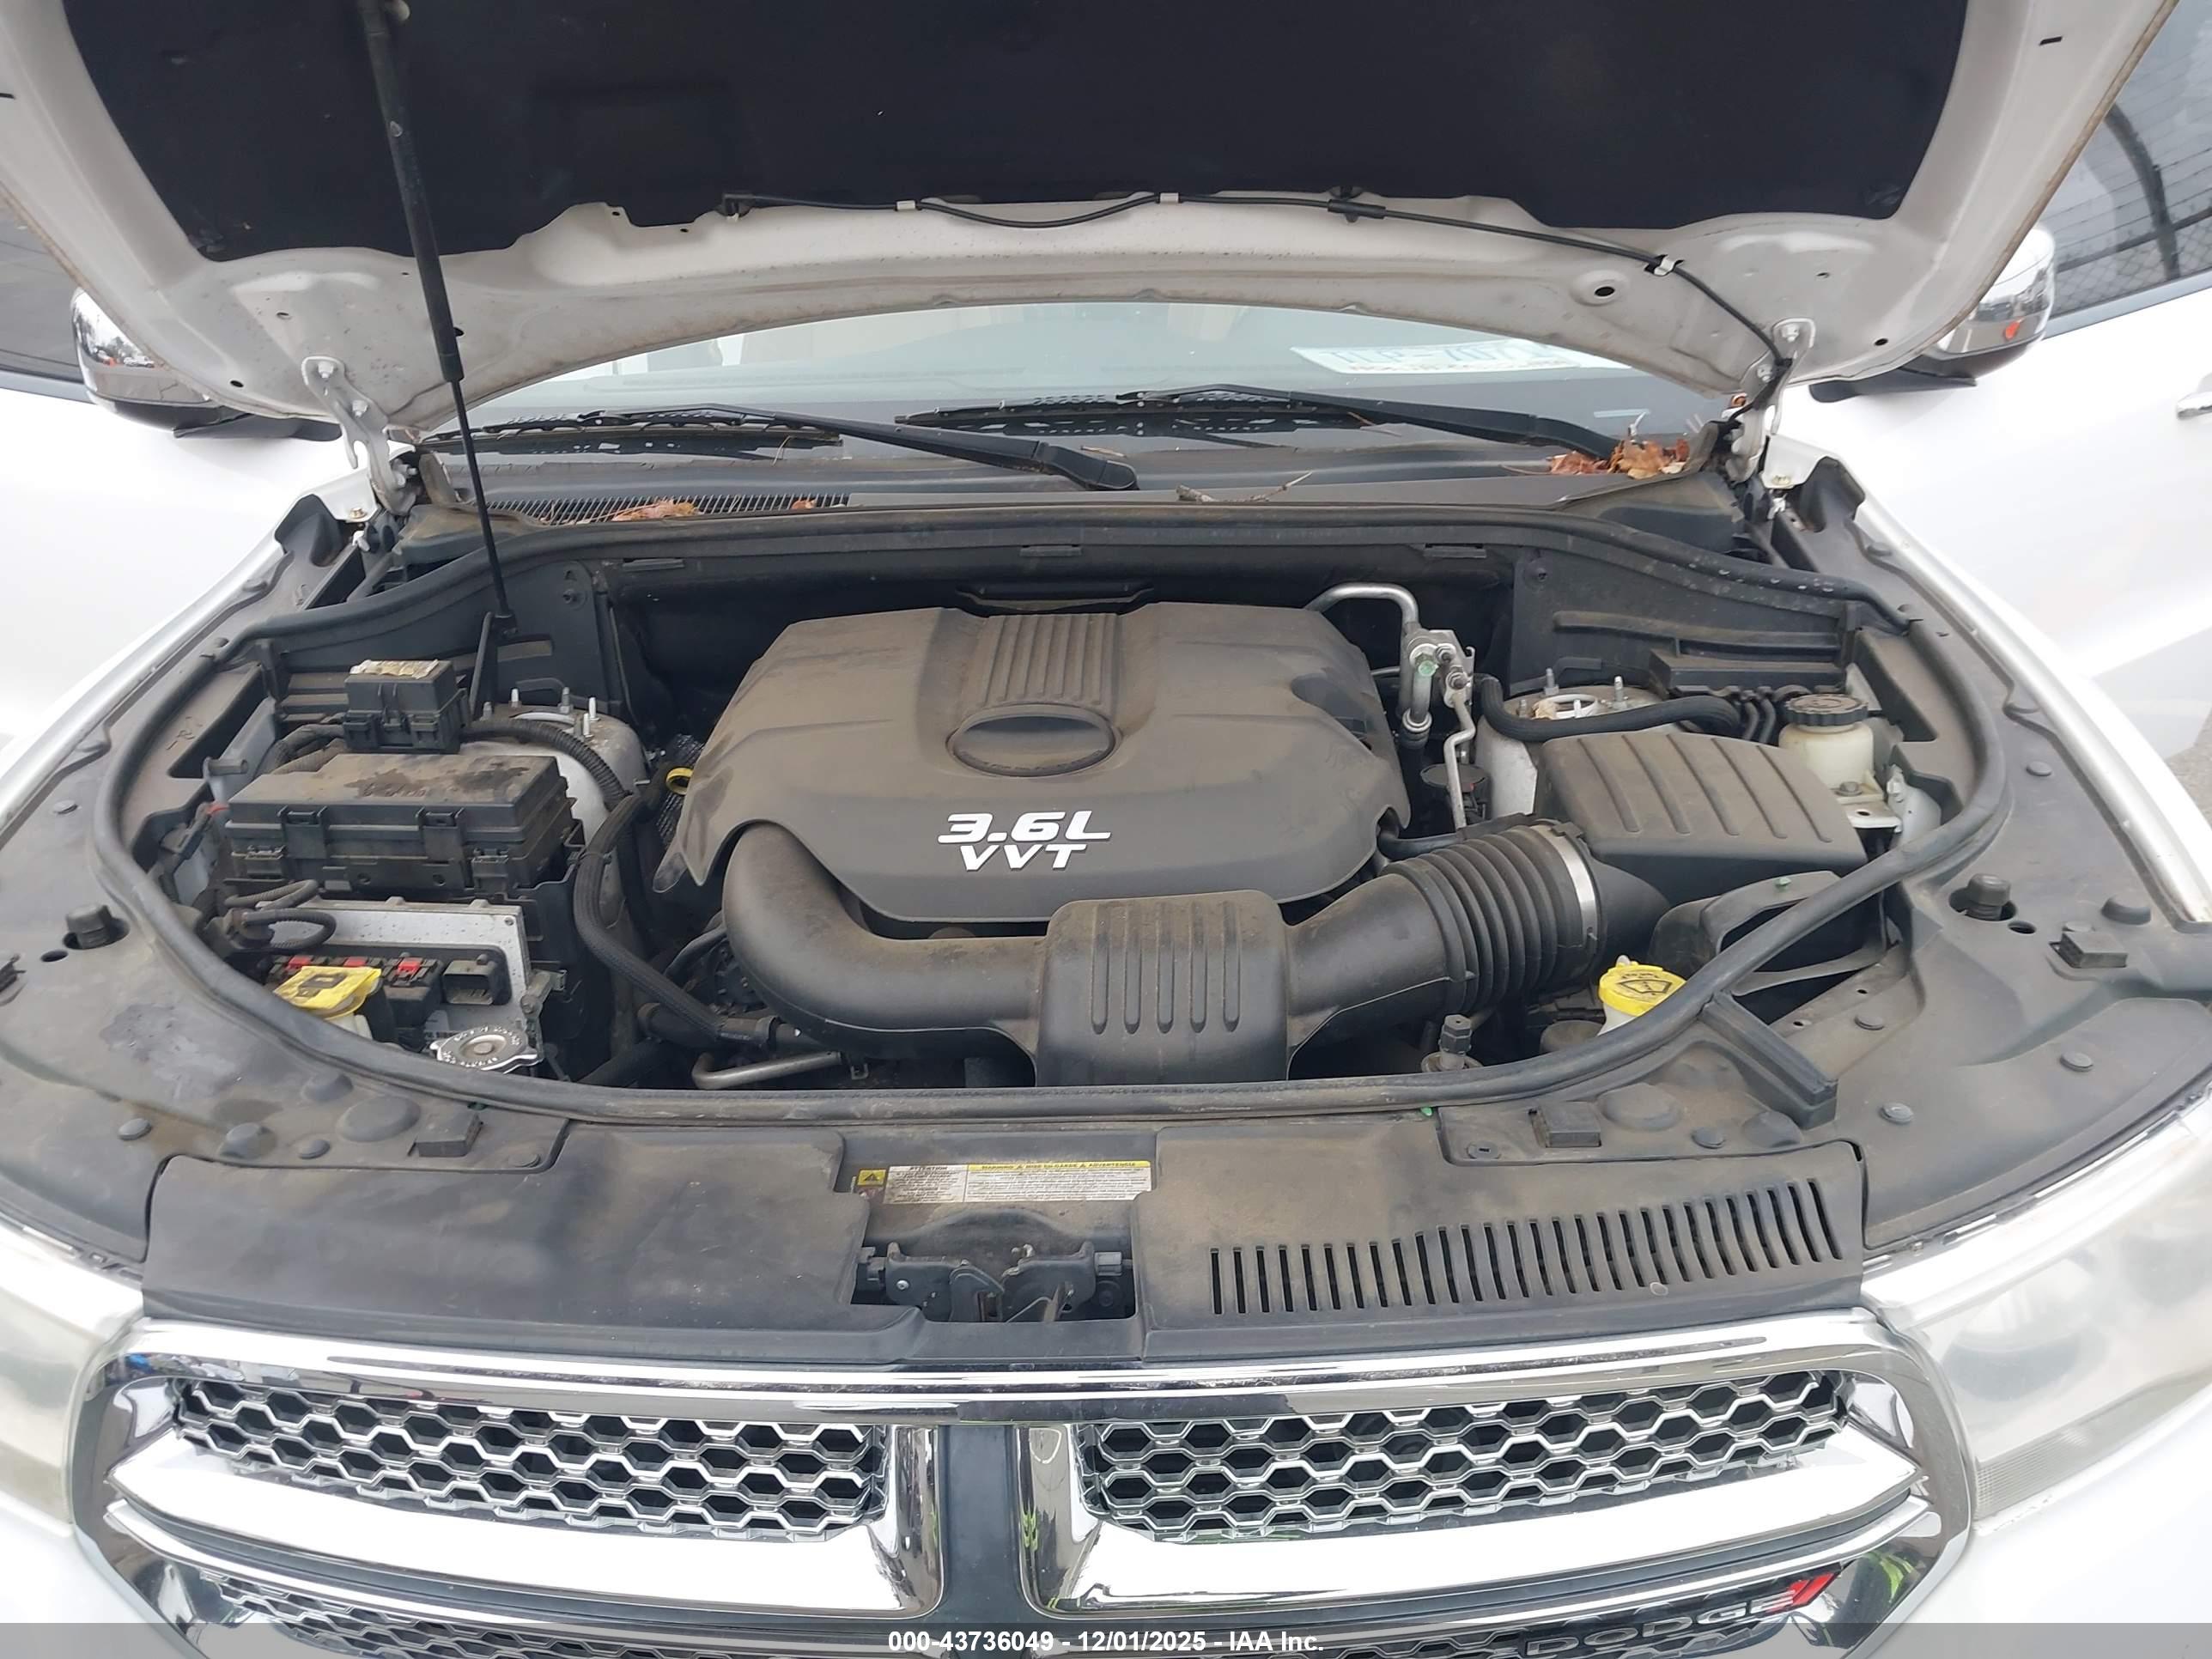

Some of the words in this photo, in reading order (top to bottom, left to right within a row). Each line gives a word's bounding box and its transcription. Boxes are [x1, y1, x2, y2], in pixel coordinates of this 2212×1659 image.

[938, 811, 1112, 843] 3.6L
[959, 844, 1087, 872] VVT
[1526, 1589, 1795, 1656] DODGE
